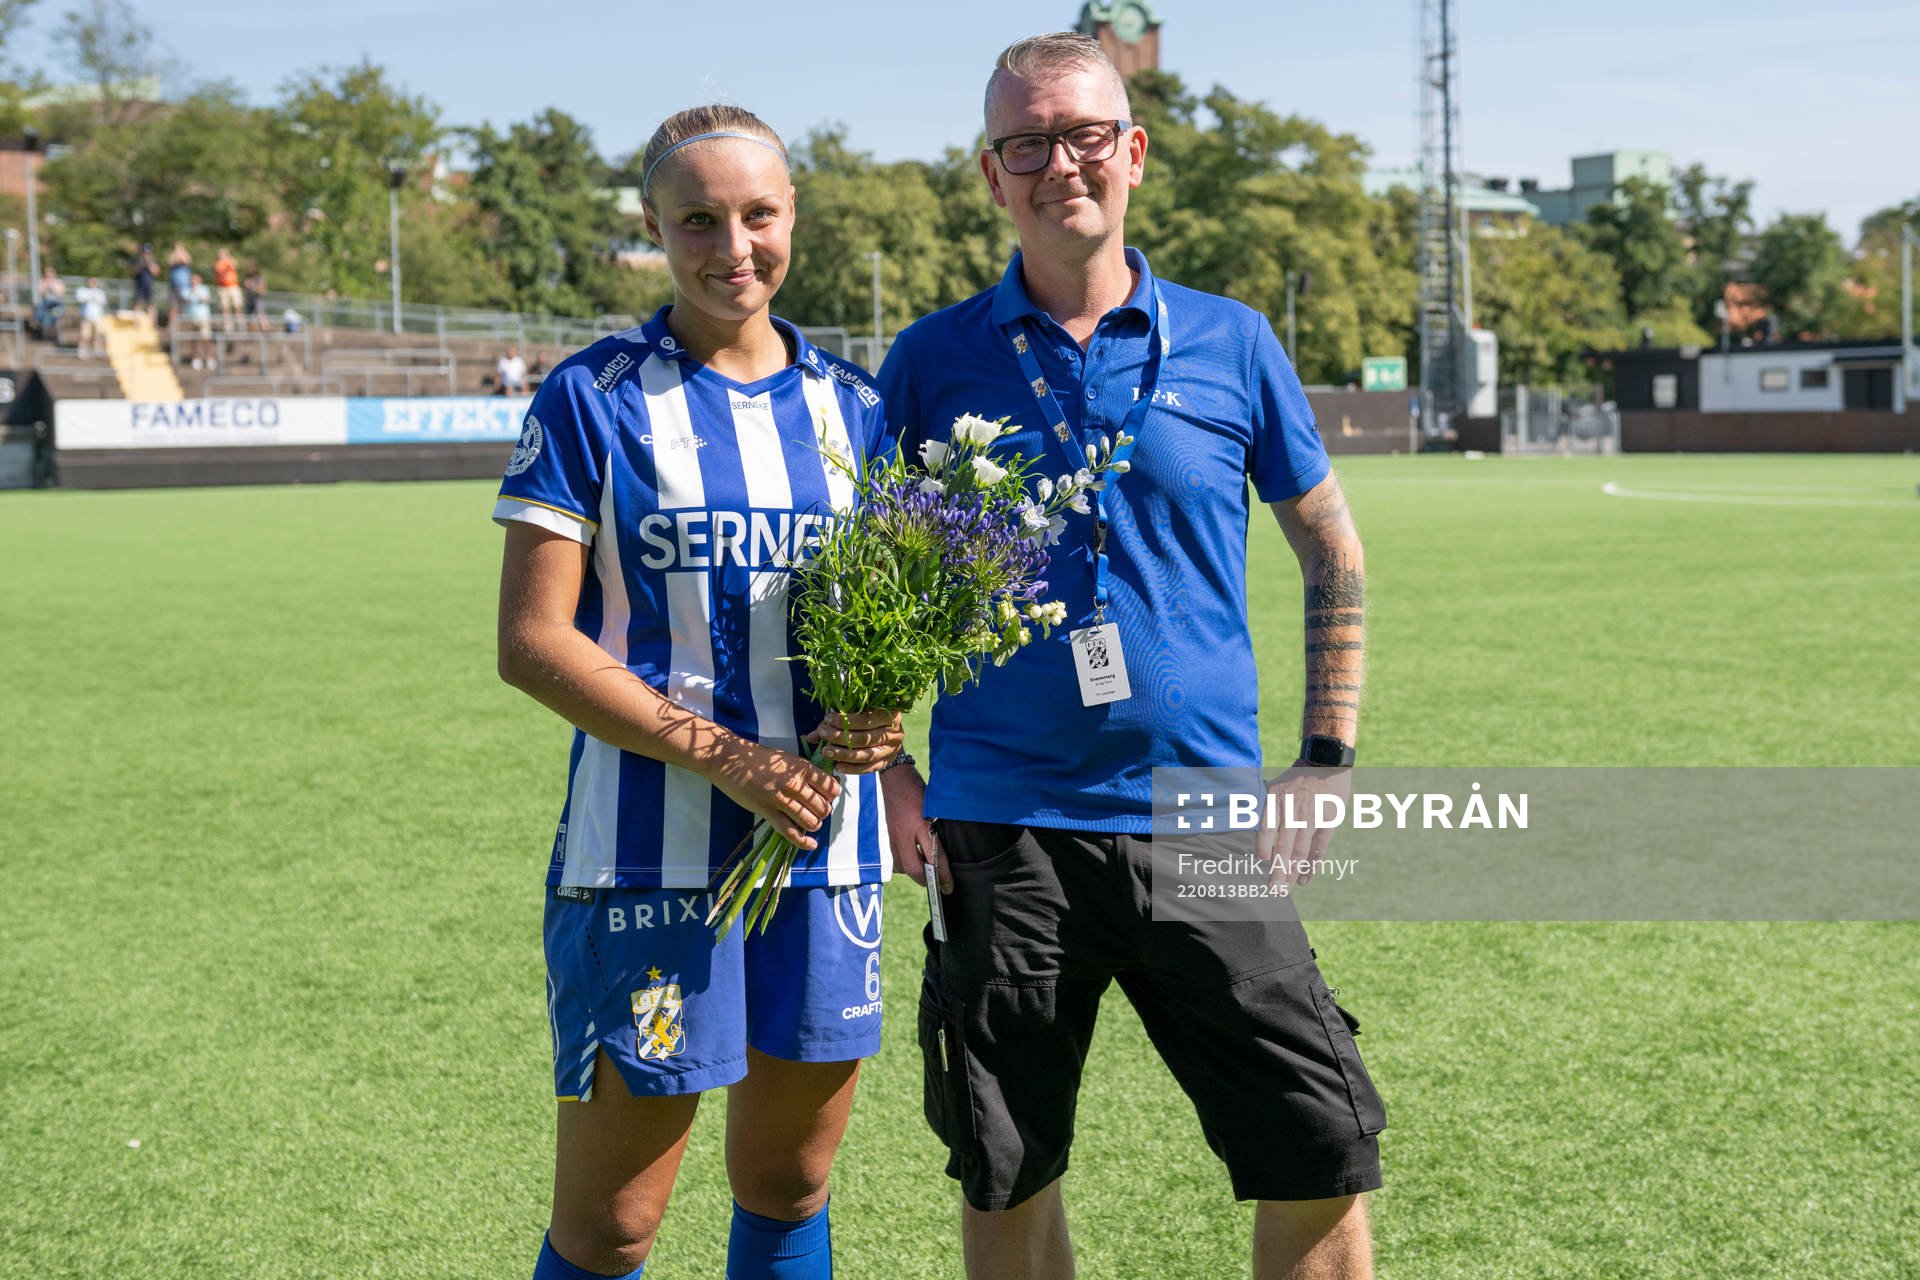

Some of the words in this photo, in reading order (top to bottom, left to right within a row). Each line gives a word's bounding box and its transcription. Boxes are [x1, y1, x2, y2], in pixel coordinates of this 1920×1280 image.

[593, 352, 630, 391] FAMECO
[829, 363, 880, 406] FAMECO
[131, 401, 279, 428] FAMECO
[383, 400, 528, 432] EFFEKT
[731, 401, 769, 410] SERNEKE
[865, 952, 880, 1001] 6
[842, 1002, 880, 1020] CRAFT
